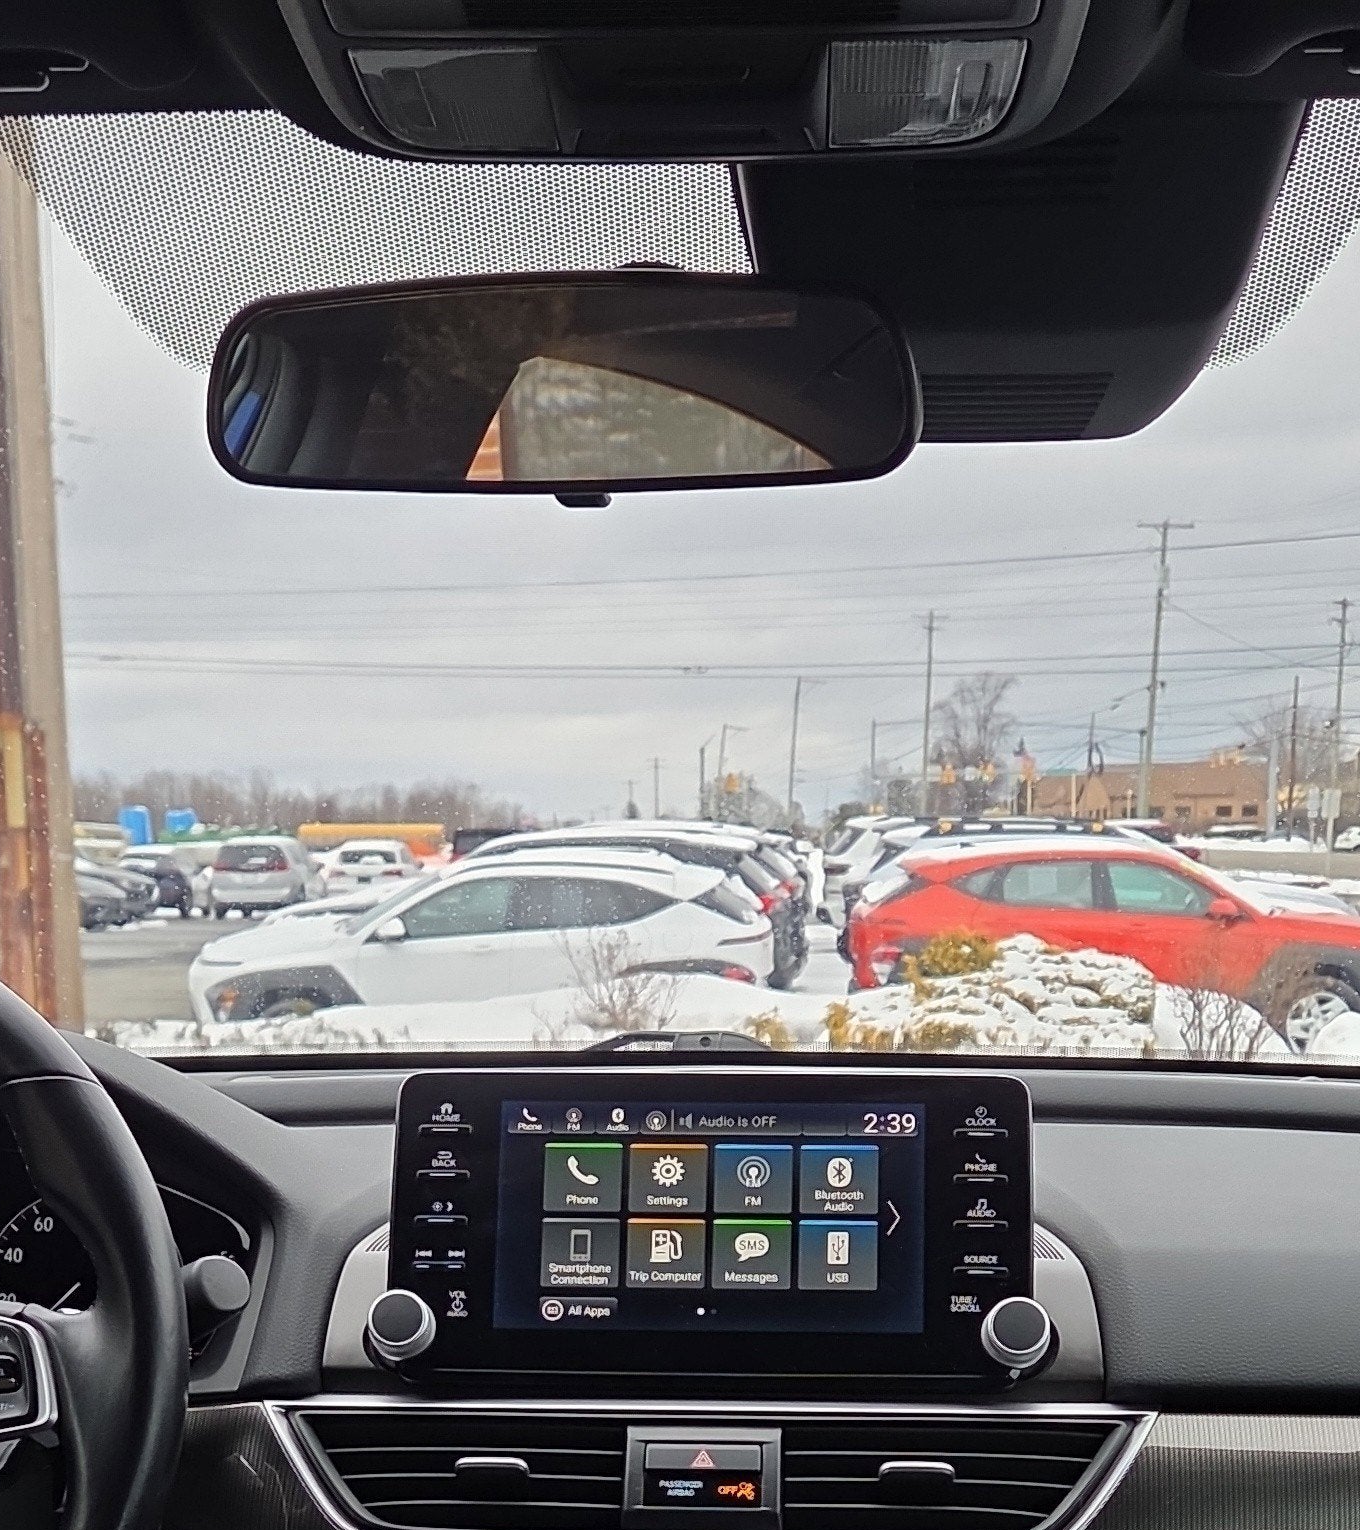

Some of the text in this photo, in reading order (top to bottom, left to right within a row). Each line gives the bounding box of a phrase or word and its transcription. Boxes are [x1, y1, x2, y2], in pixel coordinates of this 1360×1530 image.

[517, 1122, 542, 1132] Phone
[566, 1123, 581, 1132] FM
[605, 1123, 630, 1132] Audio
[698, 1115, 777, 1129] Audio is OFF
[862, 1112, 916, 1135] 2:39
[965, 1117, 997, 1127] CLOCK
[431, 1158, 457, 1168] BACK
[964, 1162, 997, 1172] PHONE
[566, 1194, 599, 1206] Phone
[646, 1194, 688, 1208] Settings
[814, 1189, 865, 1201] Bluetooth
[744, 1196, 762, 1207] FM
[823, 1201, 854, 1213] Audio
[966, 1208, 997, 1218] AUDIO
[33, 1216, 54, 1232] 60
[739, 1240, 766, 1251] SMS
[3, 1247, 24, 1263] 40
[963, 1254, 998, 1264] SOURCE
[548, 1263, 612, 1276] Smartphone
[550, 1275, 608, 1286] Connection
[630, 1271, 702, 1284] Trip Computer
[724, 1271, 779, 1285] Messages
[826, 1272, 849, 1284] USB
[568, 1304, 611, 1319] All Apps
